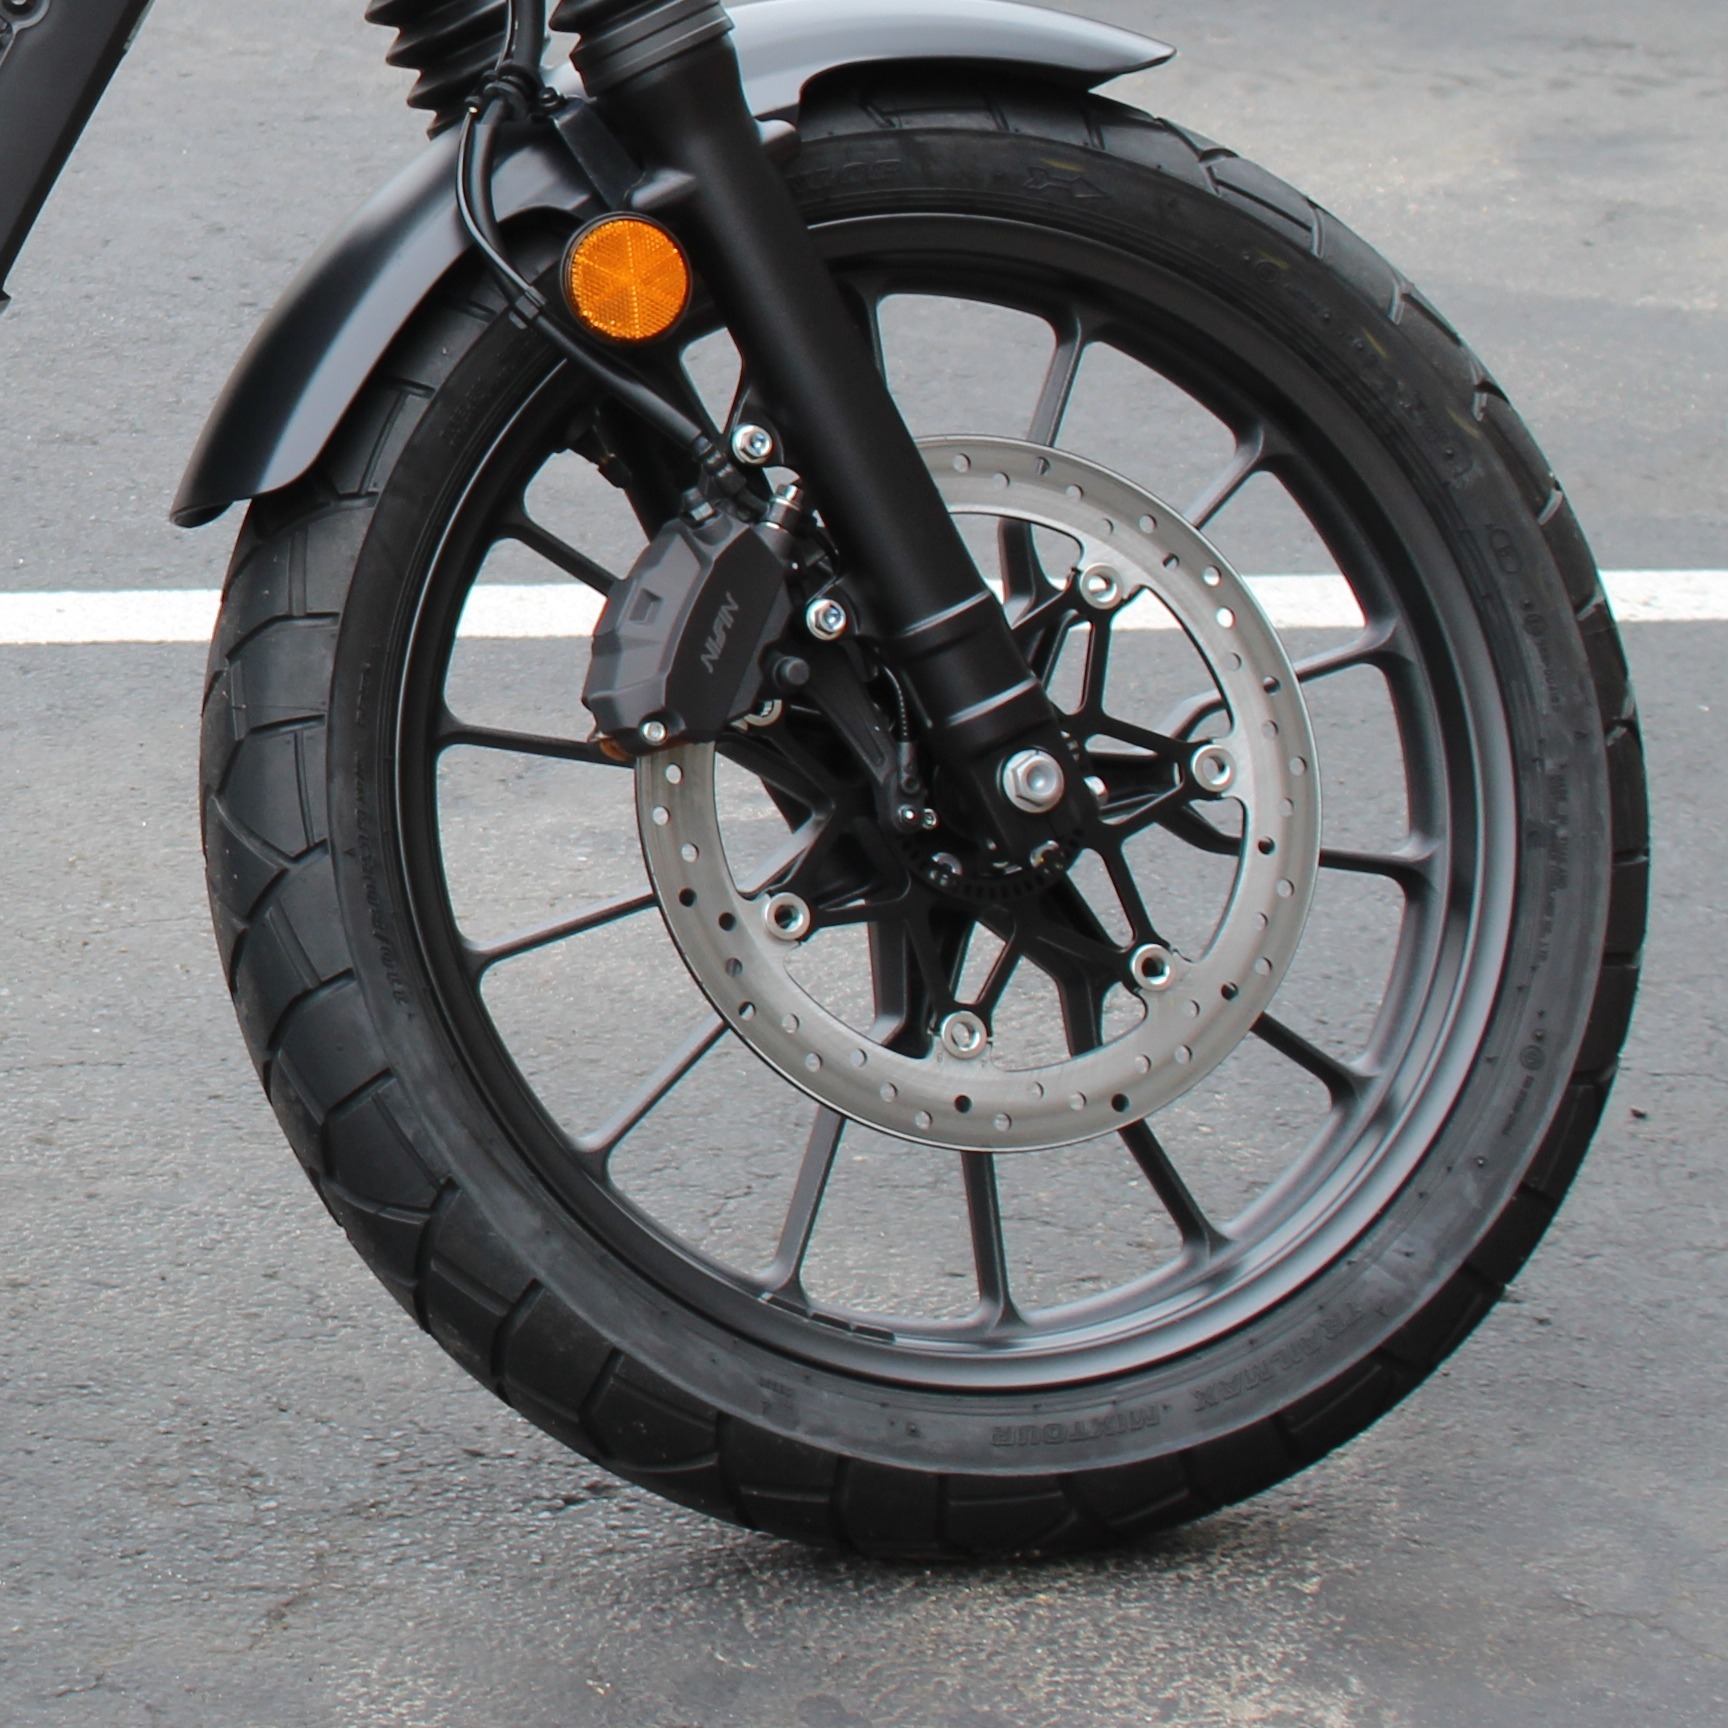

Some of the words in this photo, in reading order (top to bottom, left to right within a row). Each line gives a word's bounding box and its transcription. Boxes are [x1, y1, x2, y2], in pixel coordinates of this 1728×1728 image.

[700, 590, 740, 674] NISSIN
[1190, 1301, 1365, 1413] TRAILMAX
[990, 1406, 1162, 1448] MIXTOUR
